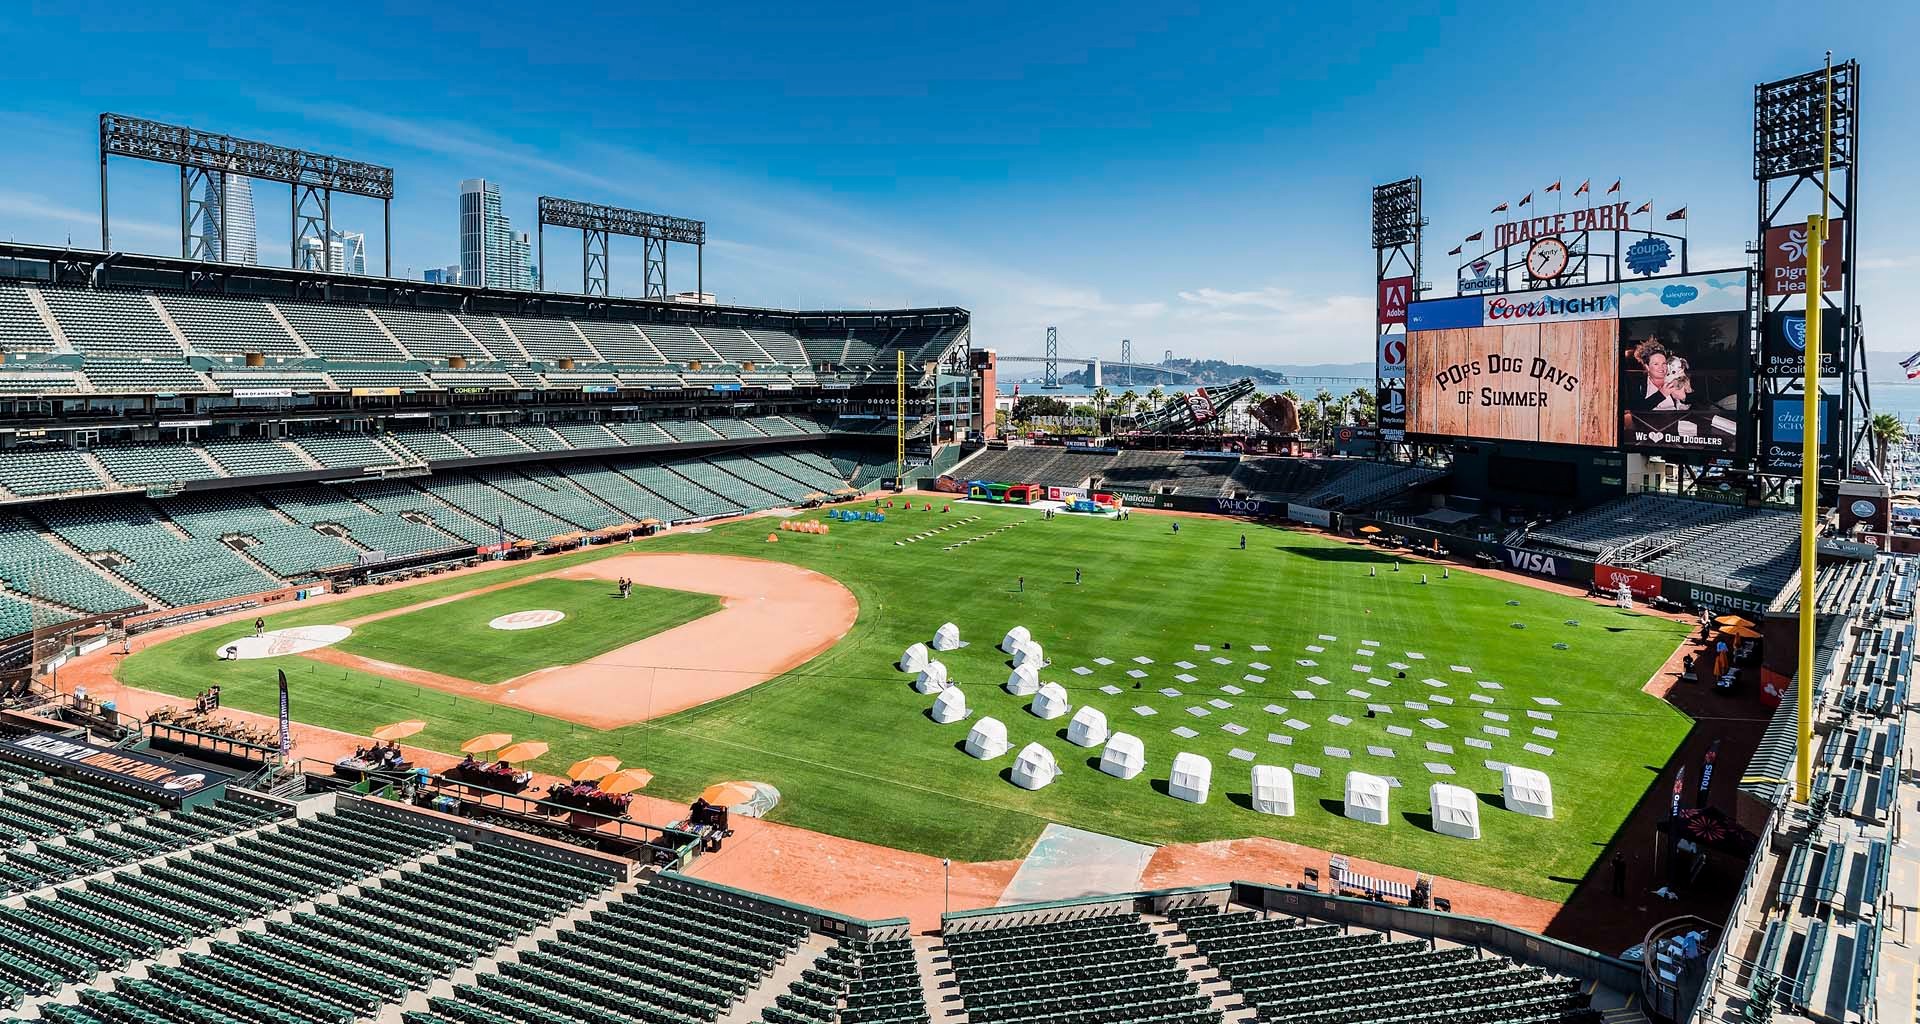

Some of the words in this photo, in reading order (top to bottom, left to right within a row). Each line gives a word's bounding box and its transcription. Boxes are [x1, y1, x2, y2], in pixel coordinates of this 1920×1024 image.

[1494, 214, 1566, 250] ORACLE
[1573, 201, 1631, 231] PARK
[1630, 243, 1667, 255] coupa
[1775, 265, 1829, 280] Digny
[1459, 277, 1504, 290] Fanatics
[1777, 281, 1831, 292] Heah.
[1387, 307, 1405, 317] Adobe
[1489, 297, 1547, 320] Coors
[1550, 296, 1607, 315] LIGHT
[1771, 356, 1794, 364] Blue
[1767, 365, 1777, 373] of
[1780, 365, 1836, 374] Calinia
[1031, 415, 1096, 427] nuveen
[1778, 411, 1821, 422] char
[1769, 446, 1796, 456] Own
[1768, 457, 1833, 469] tomor
[1062, 491, 1085, 499] TOYOTA
[1122, 492, 1156, 504] National
[1218, 499, 1260, 512] YAHOO!
[1506, 548, 1556, 576] VISA
[1700, 764, 1712, 791] TOURS
